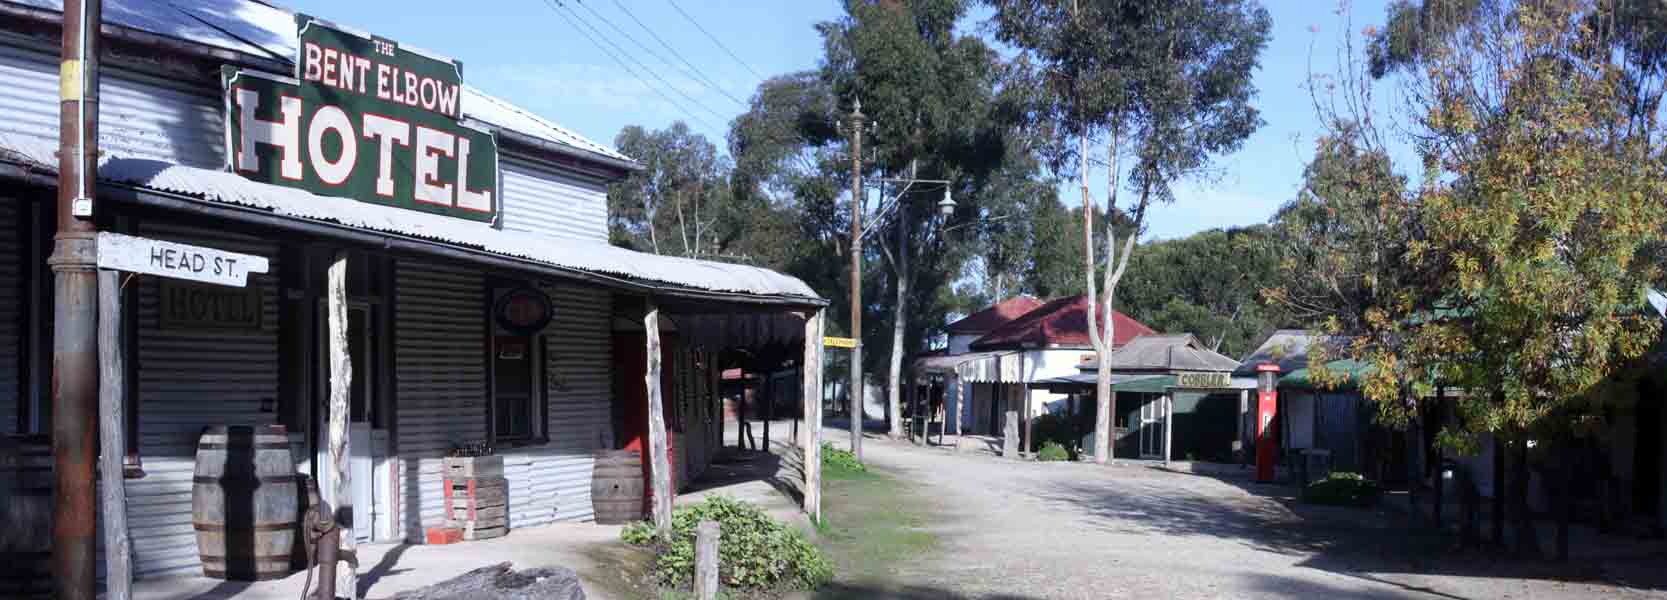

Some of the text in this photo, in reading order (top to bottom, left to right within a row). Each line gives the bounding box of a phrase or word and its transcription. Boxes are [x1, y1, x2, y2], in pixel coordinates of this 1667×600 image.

[372, 40, 394, 56] THE
[304, 43, 458, 117] BENT ELBOW
[236, 87, 492, 212] HOTEL
[150, 246, 239, 278] HEAD ST.
